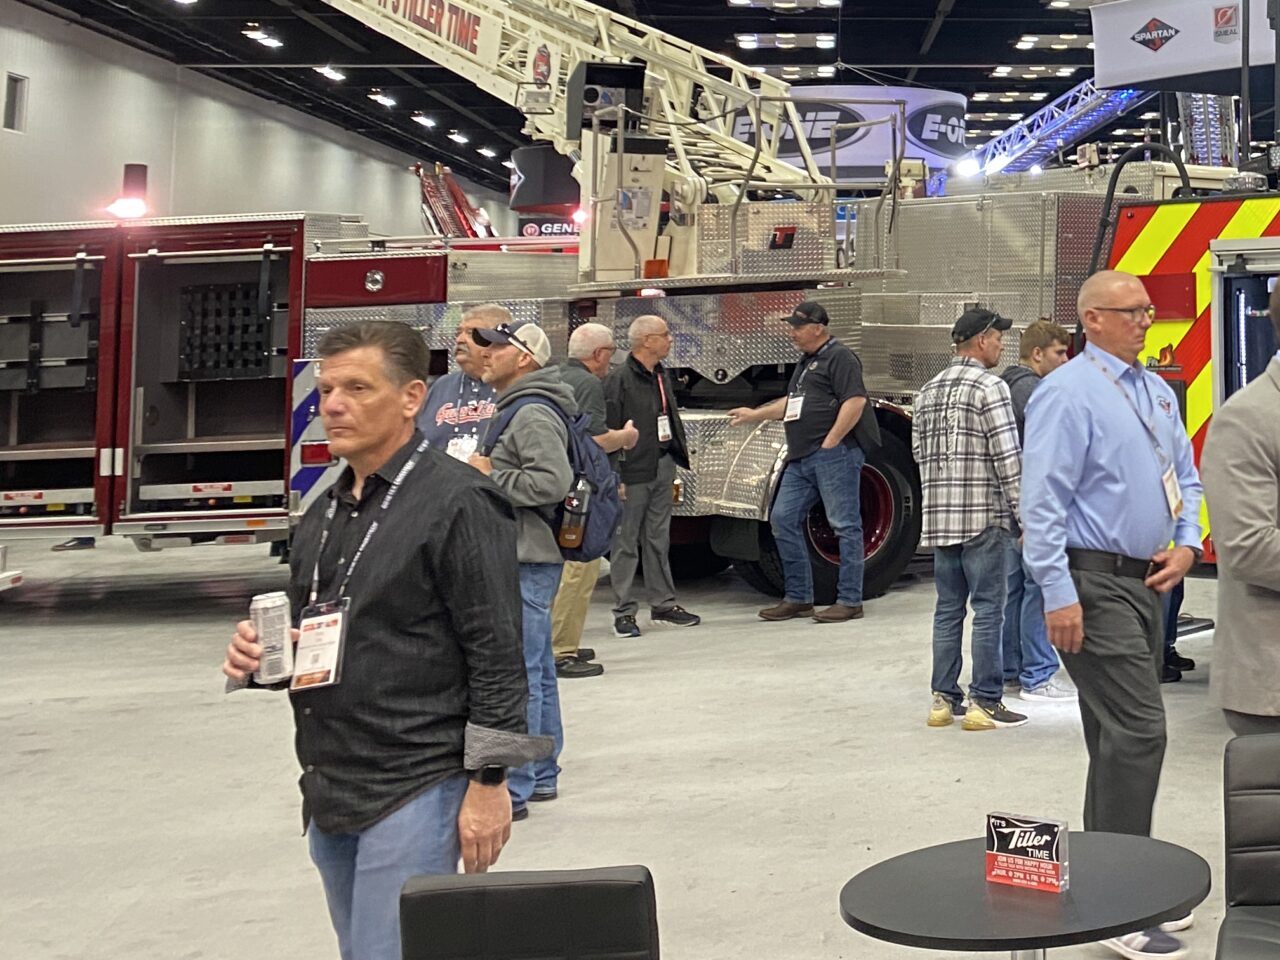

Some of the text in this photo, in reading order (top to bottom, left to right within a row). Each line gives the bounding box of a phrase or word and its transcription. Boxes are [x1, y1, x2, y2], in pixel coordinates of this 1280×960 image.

[447, 3, 481, 55] TIME
[1134, 28, 1176, 41] SPARTAN
[996, 828, 1051, 849] Tiller
[1026, 848, 1050, 860] TIME
